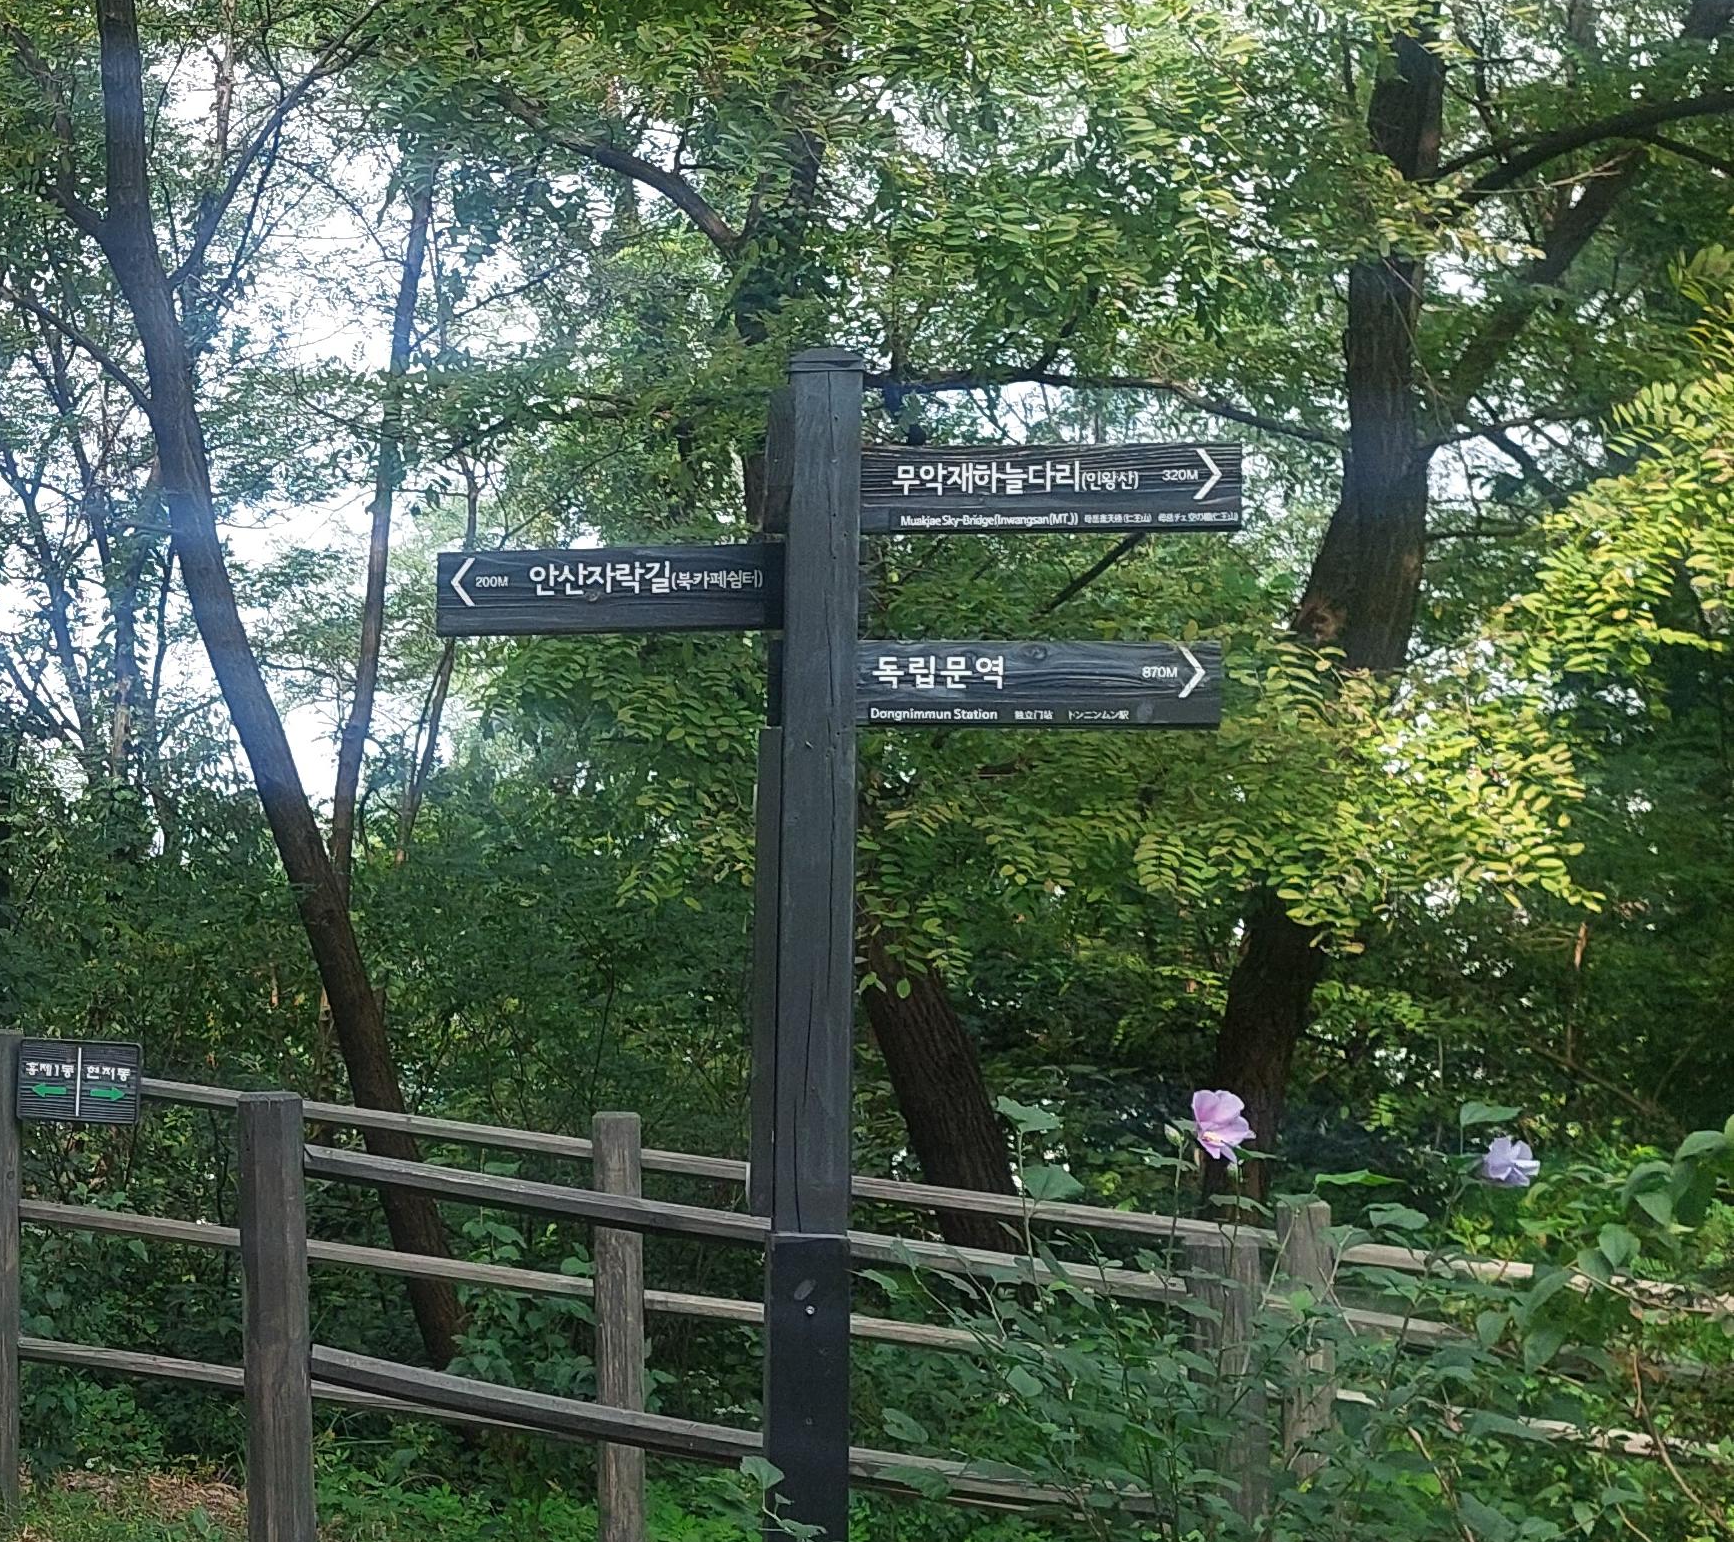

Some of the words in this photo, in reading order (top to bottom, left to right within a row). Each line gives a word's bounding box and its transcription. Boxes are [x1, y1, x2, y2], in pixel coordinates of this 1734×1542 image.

[1162, 469, 1199, 481] 320M
[475, 575, 509, 589] 200M
[872, 655, 1005, 690] 독립문역
[1141, 665, 1178, 679] 870M
[870, 707, 952, 723] Dongnimmun
[953, 707, 998, 721] Station
